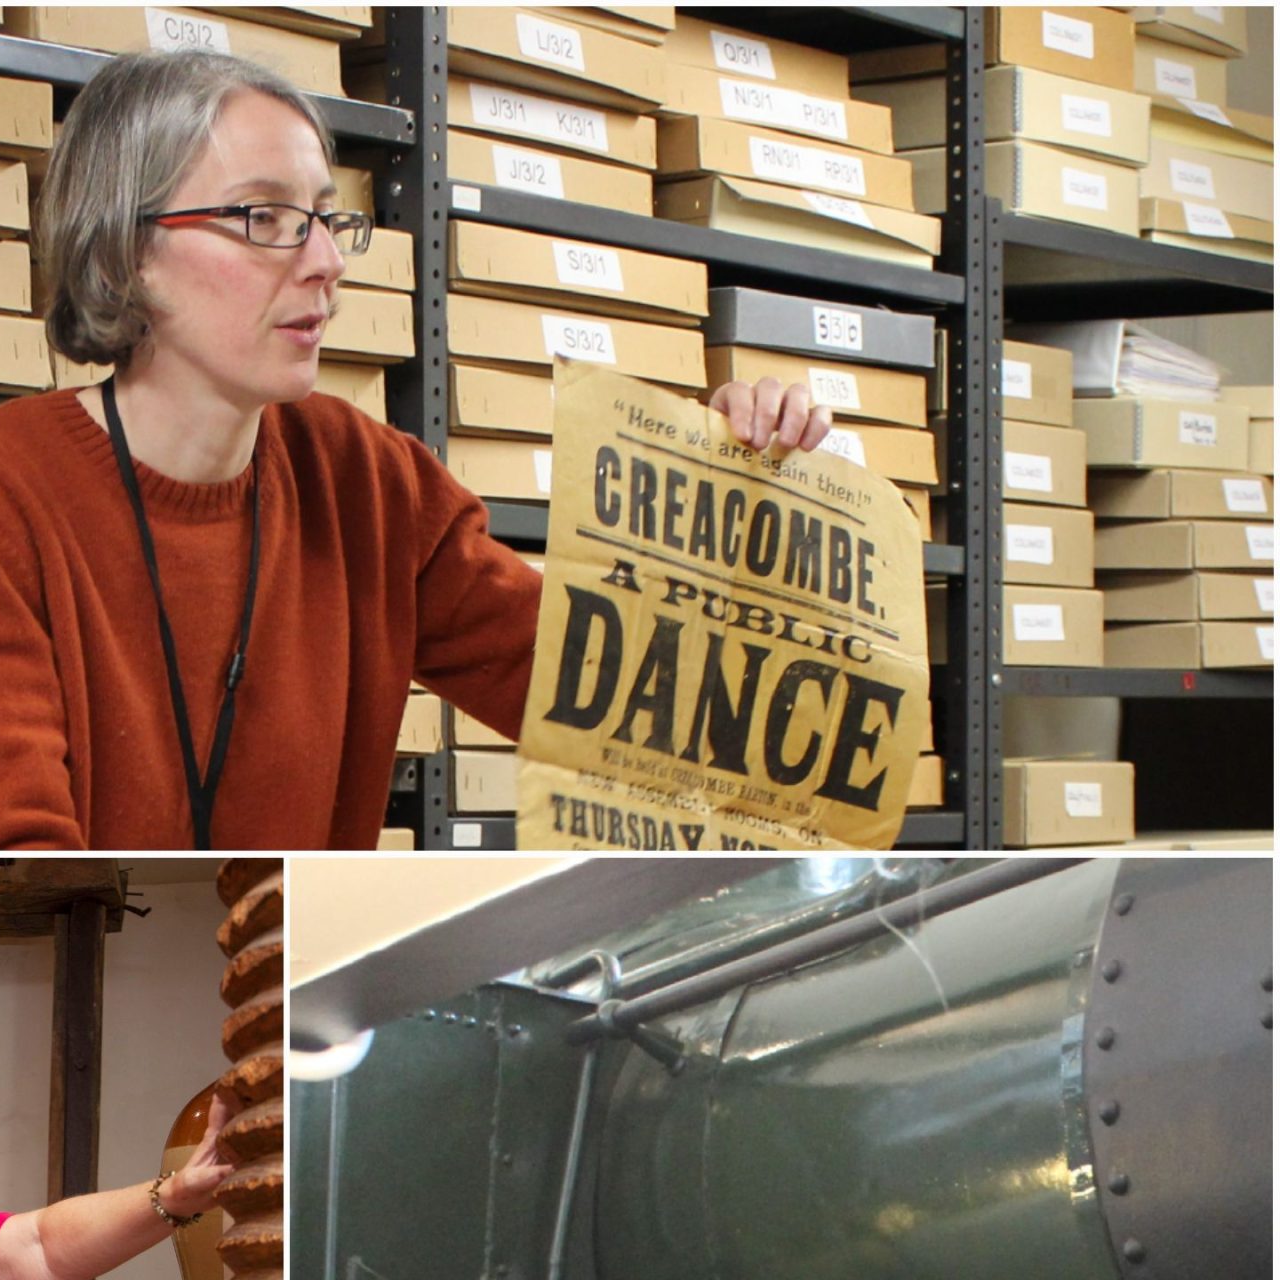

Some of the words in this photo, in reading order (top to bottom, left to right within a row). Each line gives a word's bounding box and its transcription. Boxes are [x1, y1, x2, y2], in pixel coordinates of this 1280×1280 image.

[164, 17, 215, 48] C/3/2
[536, 29, 574, 60] L/3/2
[489, 94, 527, 122] J/3/1
[556, 110, 596, 140] K/3/1
[509, 158, 547, 186] J/3/2
[567, 249, 607, 276] S/3/1
[563, 326, 607, 354] S/3/2
[685, 428, 711, 452] we
[718, 442, 753, 462] are
[761, 456, 809, 486] again
[601, 558, 643, 593] A
[660, 576, 876, 665] PUBLIC
[543, 583, 907, 812] DANCE
